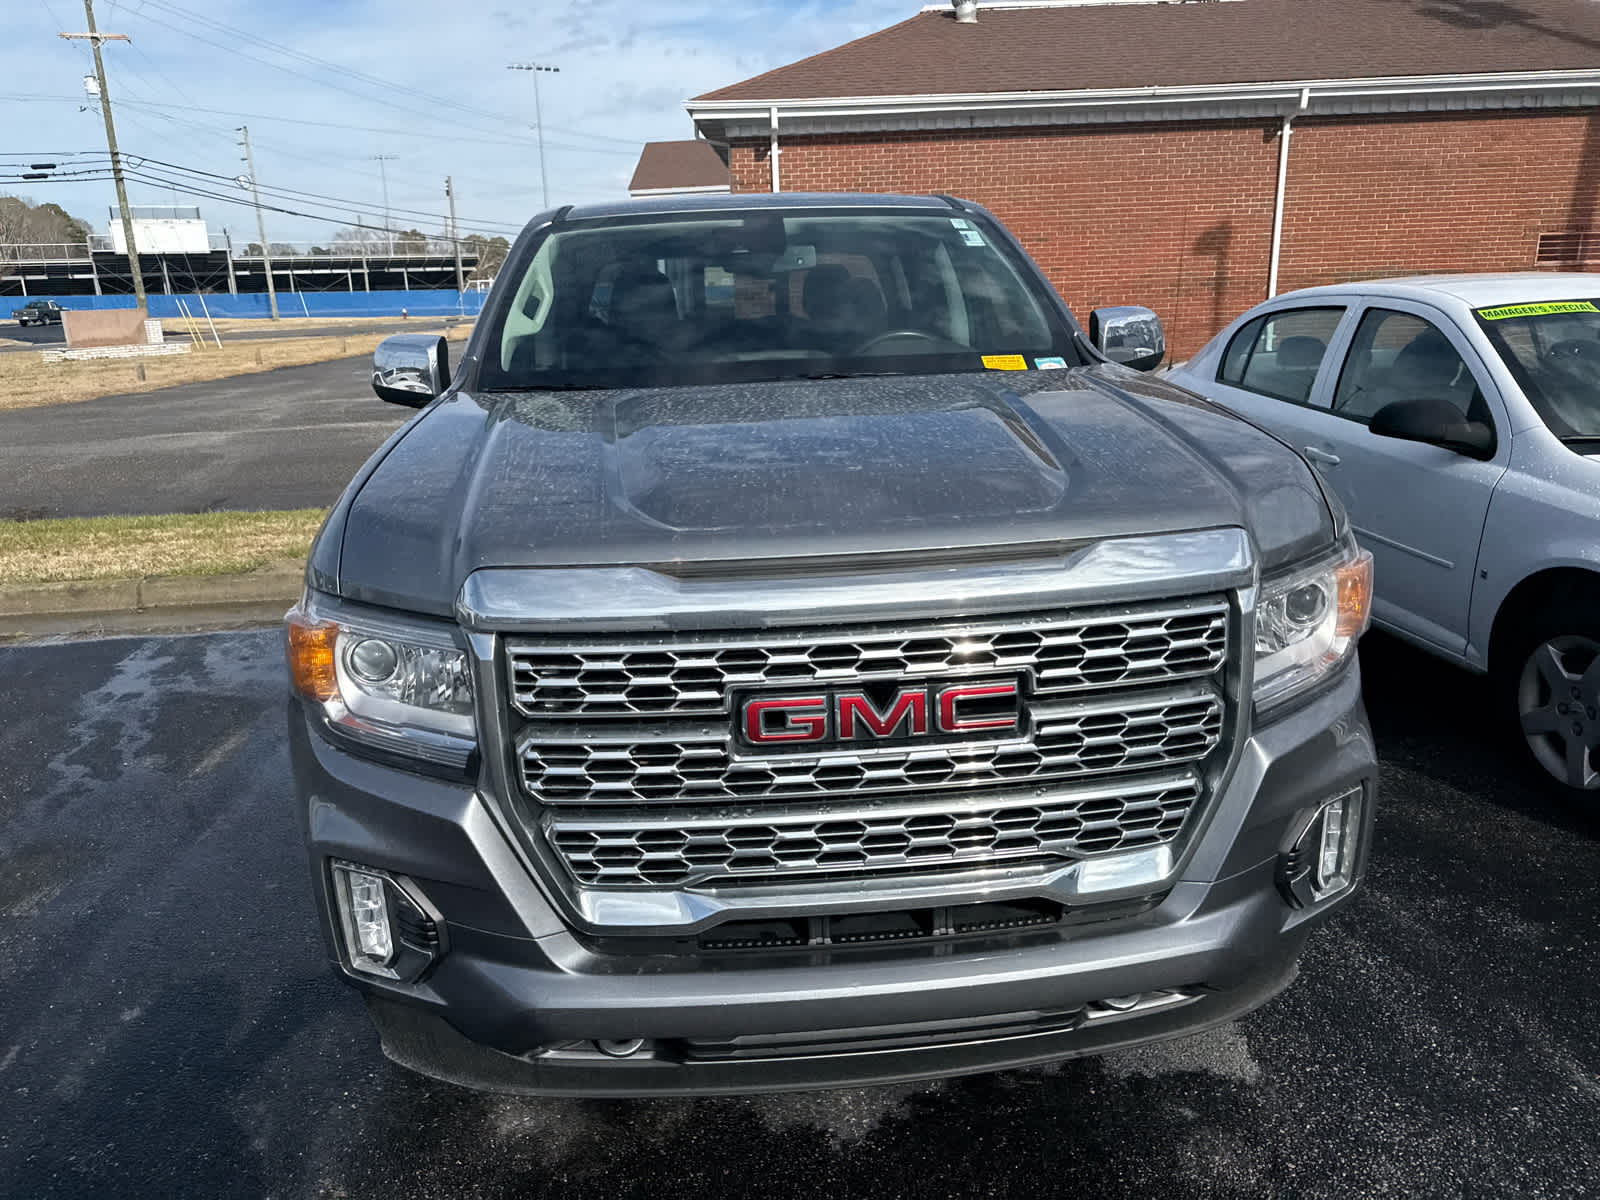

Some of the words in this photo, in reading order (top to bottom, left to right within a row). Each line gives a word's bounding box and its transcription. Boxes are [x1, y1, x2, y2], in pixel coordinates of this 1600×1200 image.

[1482, 304, 1546, 318] MANAGER'S
[1549, 303, 1595, 312] SPECIAL
[742, 679, 1018, 744] GMC
